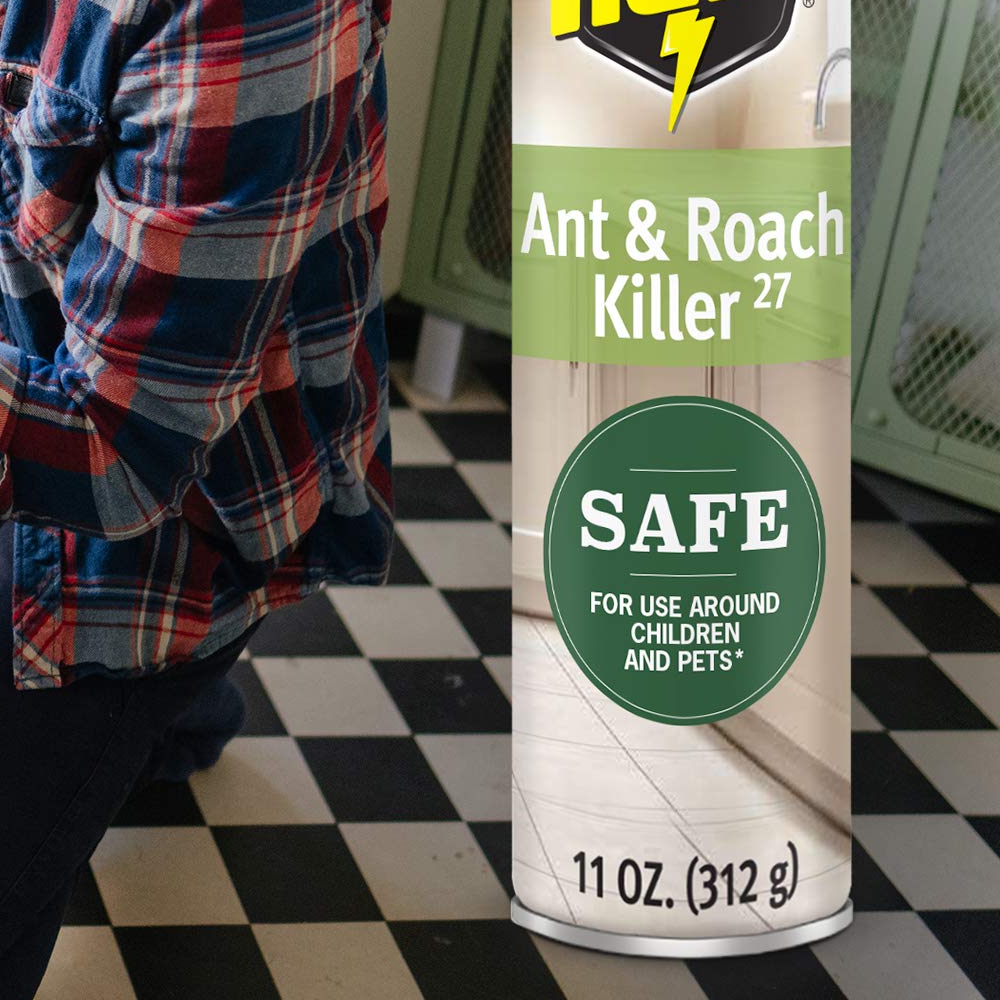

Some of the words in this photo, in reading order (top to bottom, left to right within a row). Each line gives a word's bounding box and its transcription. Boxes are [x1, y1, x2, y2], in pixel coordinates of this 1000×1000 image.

[521, 191, 610, 260] Ant
[625, 198, 670, 262] &
[688, 191, 844, 262] Roach
[595, 273, 741, 341] Killer
[753, 272, 792, 310] 27
[581, 489, 789, 553] SAFE
[590, 591, 633, 616] FOR
[640, 595, 682, 618] USE
[689, 591, 780, 617] AROUND
[631, 622, 740, 645] CHILDREN
[624, 649, 670, 671] AND
[573, 851, 604, 898] 11
[617, 858, 674, 909] OZ.
[686, 856, 758, 916] (312
[769, 841, 799, 910] g)
